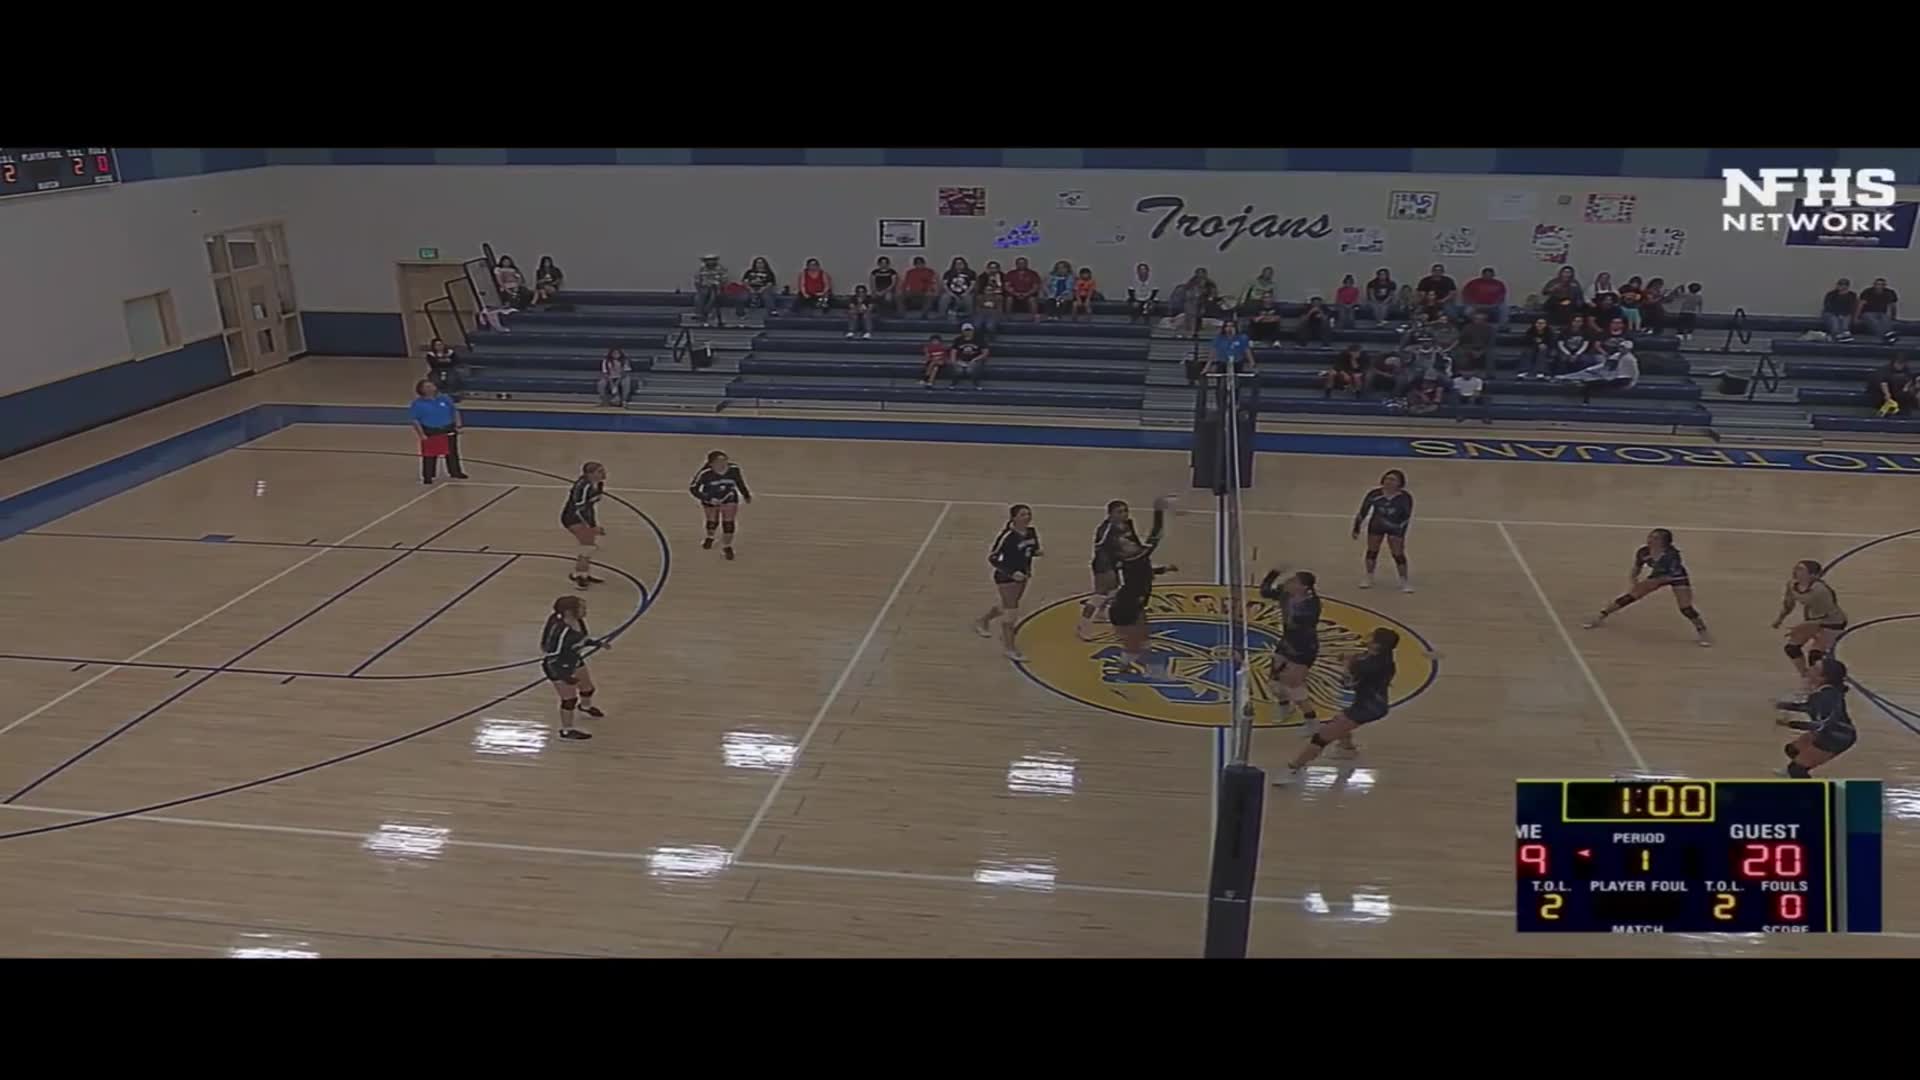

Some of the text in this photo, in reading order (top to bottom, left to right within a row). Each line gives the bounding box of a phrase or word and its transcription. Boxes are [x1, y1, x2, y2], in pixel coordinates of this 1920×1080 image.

[73, 157, 85, 175] 2
[96, 155, 110, 172] 0
[3, 164, 17, 182] 2
[1135, 196, 1333, 251] Trojans
[1410, 440, 1791, 467] TROJANS
